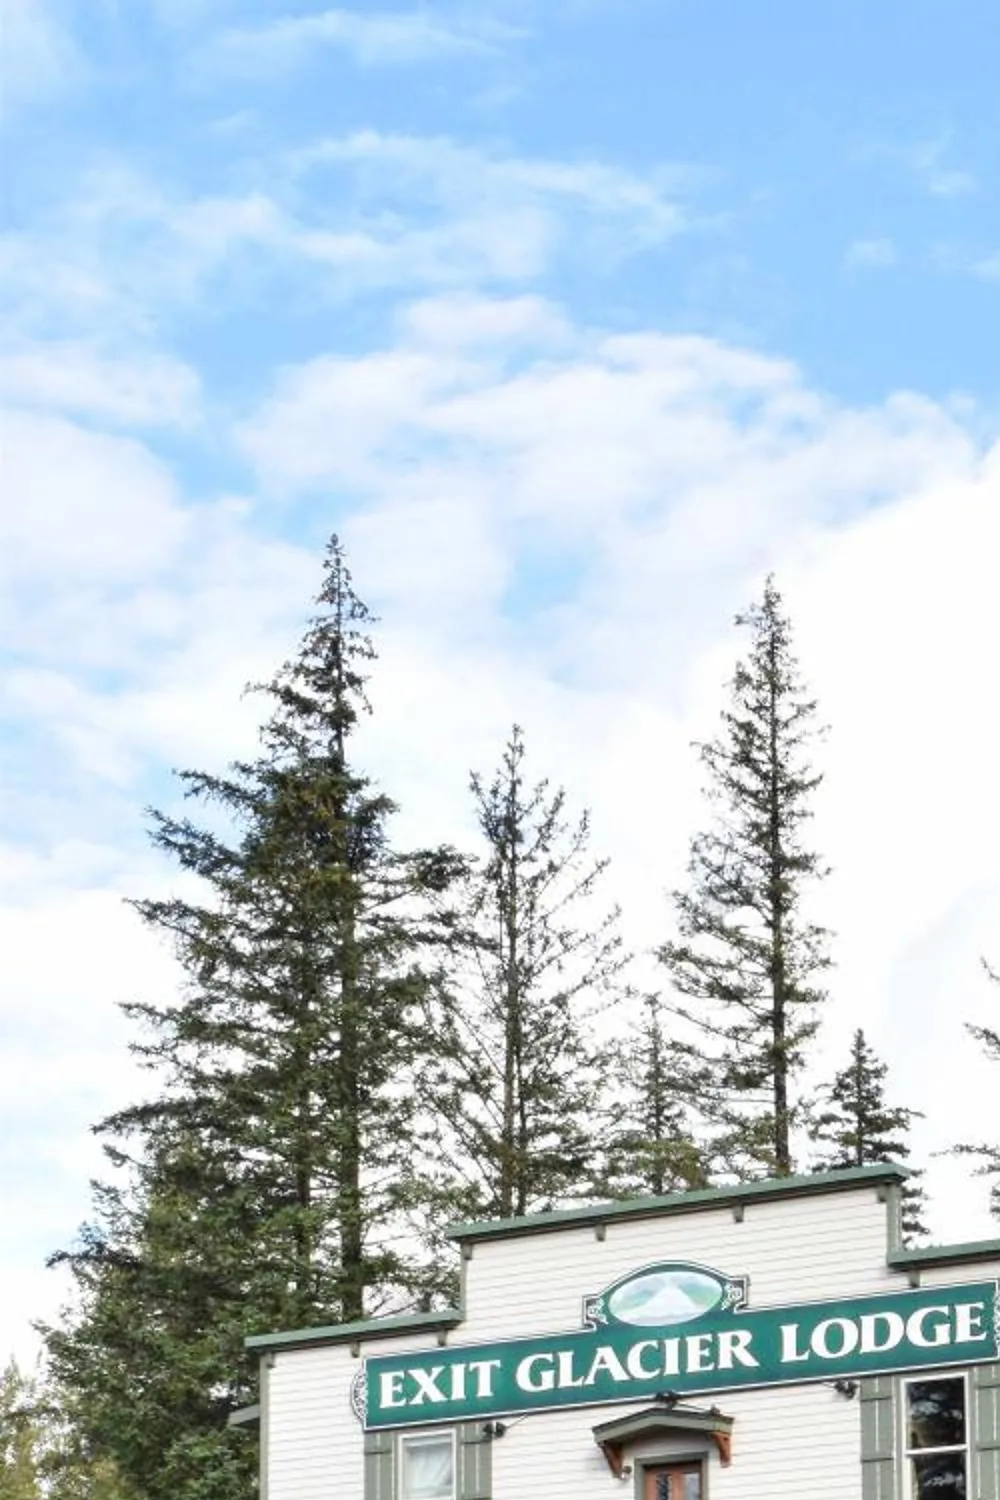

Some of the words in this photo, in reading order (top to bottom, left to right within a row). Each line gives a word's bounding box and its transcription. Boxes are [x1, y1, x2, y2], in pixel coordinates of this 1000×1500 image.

[379, 1359, 501, 1408] EXIT
[515, 1329, 760, 1392] GLACIER
[779, 1302, 988, 1363] LODGE
